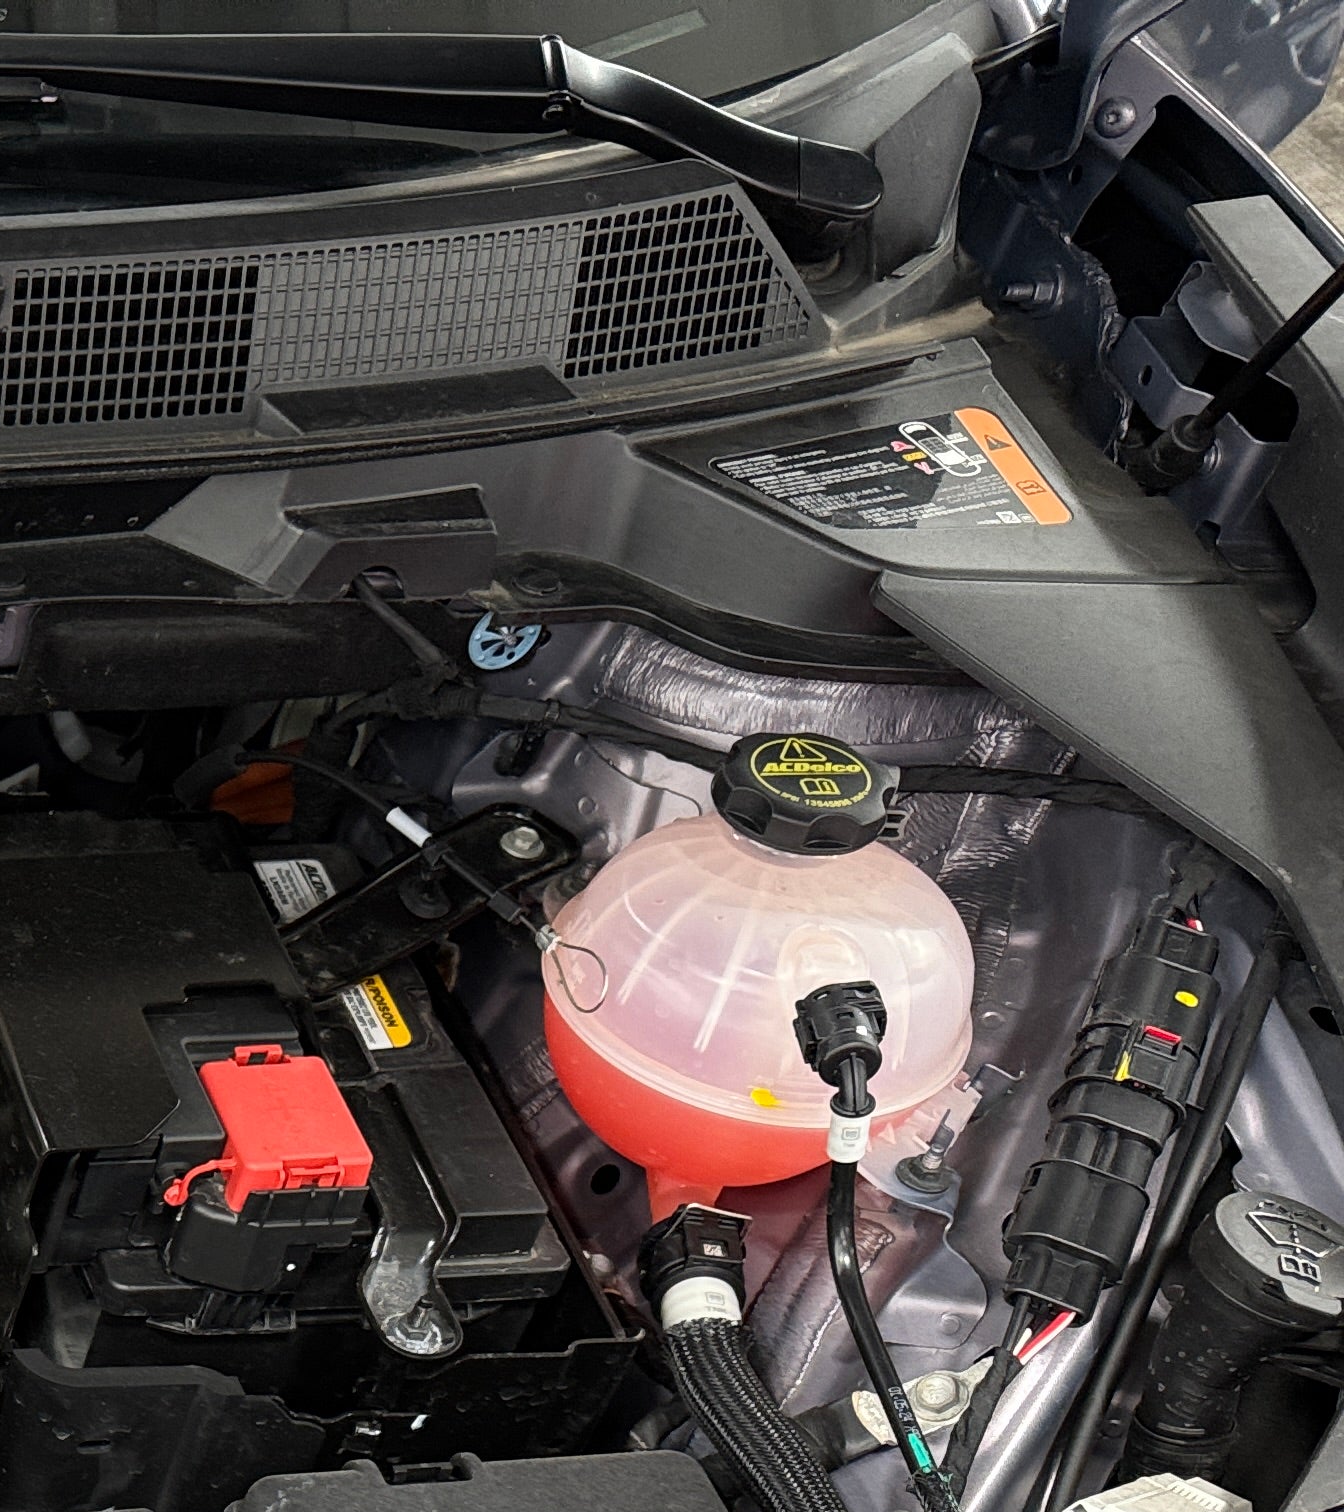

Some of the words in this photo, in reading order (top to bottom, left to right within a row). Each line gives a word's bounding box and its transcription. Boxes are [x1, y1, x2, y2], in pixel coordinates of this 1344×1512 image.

[762, 762, 862, 773] ACDelco
[301, 864, 328, 901] ACDe
[365, 978, 399, 1028] R/POISON
